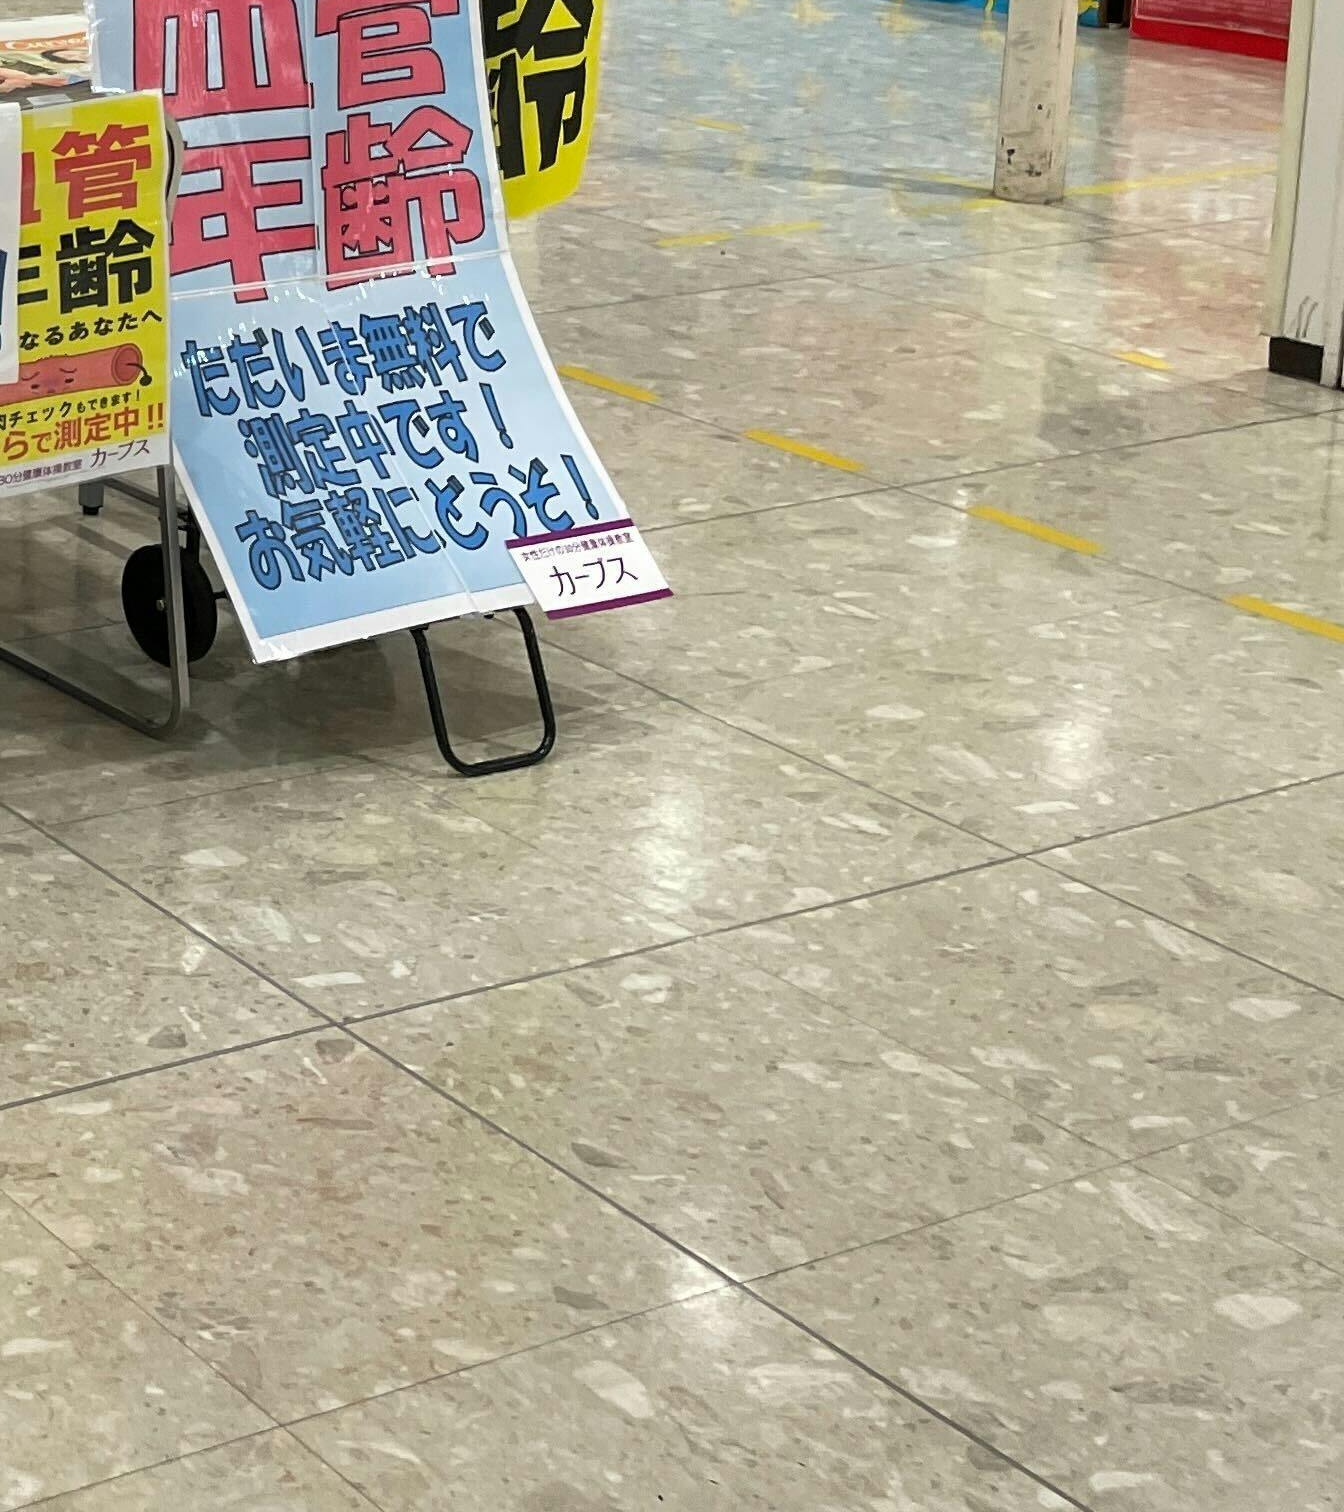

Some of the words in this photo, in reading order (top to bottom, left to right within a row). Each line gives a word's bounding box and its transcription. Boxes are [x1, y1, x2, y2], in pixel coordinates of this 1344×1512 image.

[19, 122, 153, 222] 管
[171, 104, 485, 304] 年齢
[19, 309, 163, 351] なるあなたへ
[181, 300, 509, 418] ただいま無料で
[90, 439, 151, 469] カーブス
[238, 383, 515, 500] 測定中です！
[235, 454, 600, 591] お気軽にどうぞ！
[549, 556, 639, 597] カーブス
